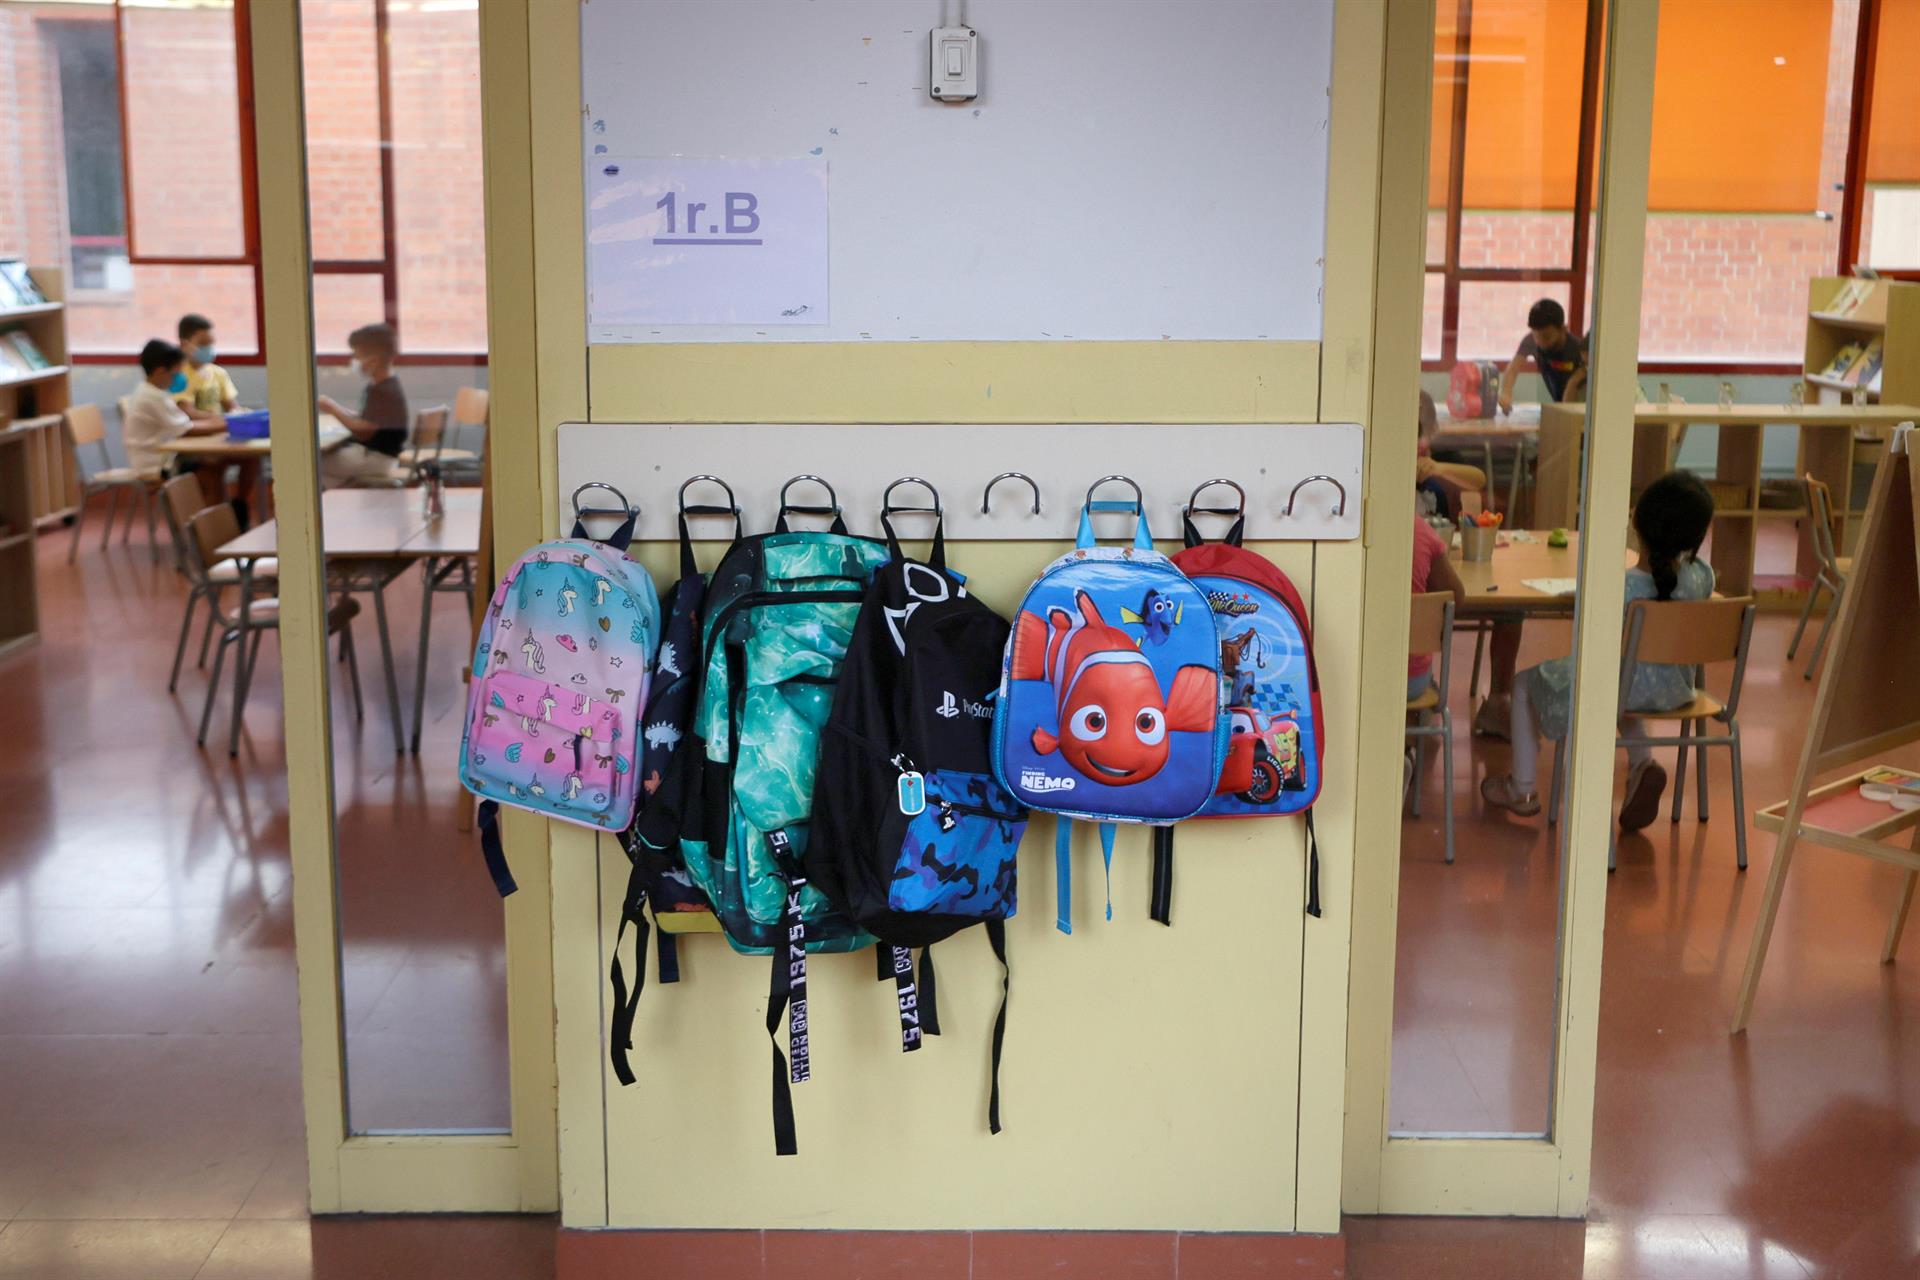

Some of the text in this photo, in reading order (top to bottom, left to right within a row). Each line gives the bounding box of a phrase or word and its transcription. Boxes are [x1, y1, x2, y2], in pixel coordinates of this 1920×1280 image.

[656, 191, 761, 234] 1r.B
[1021, 775, 1076, 790] NEMO
[898, 983, 921, 1050] 1975.
